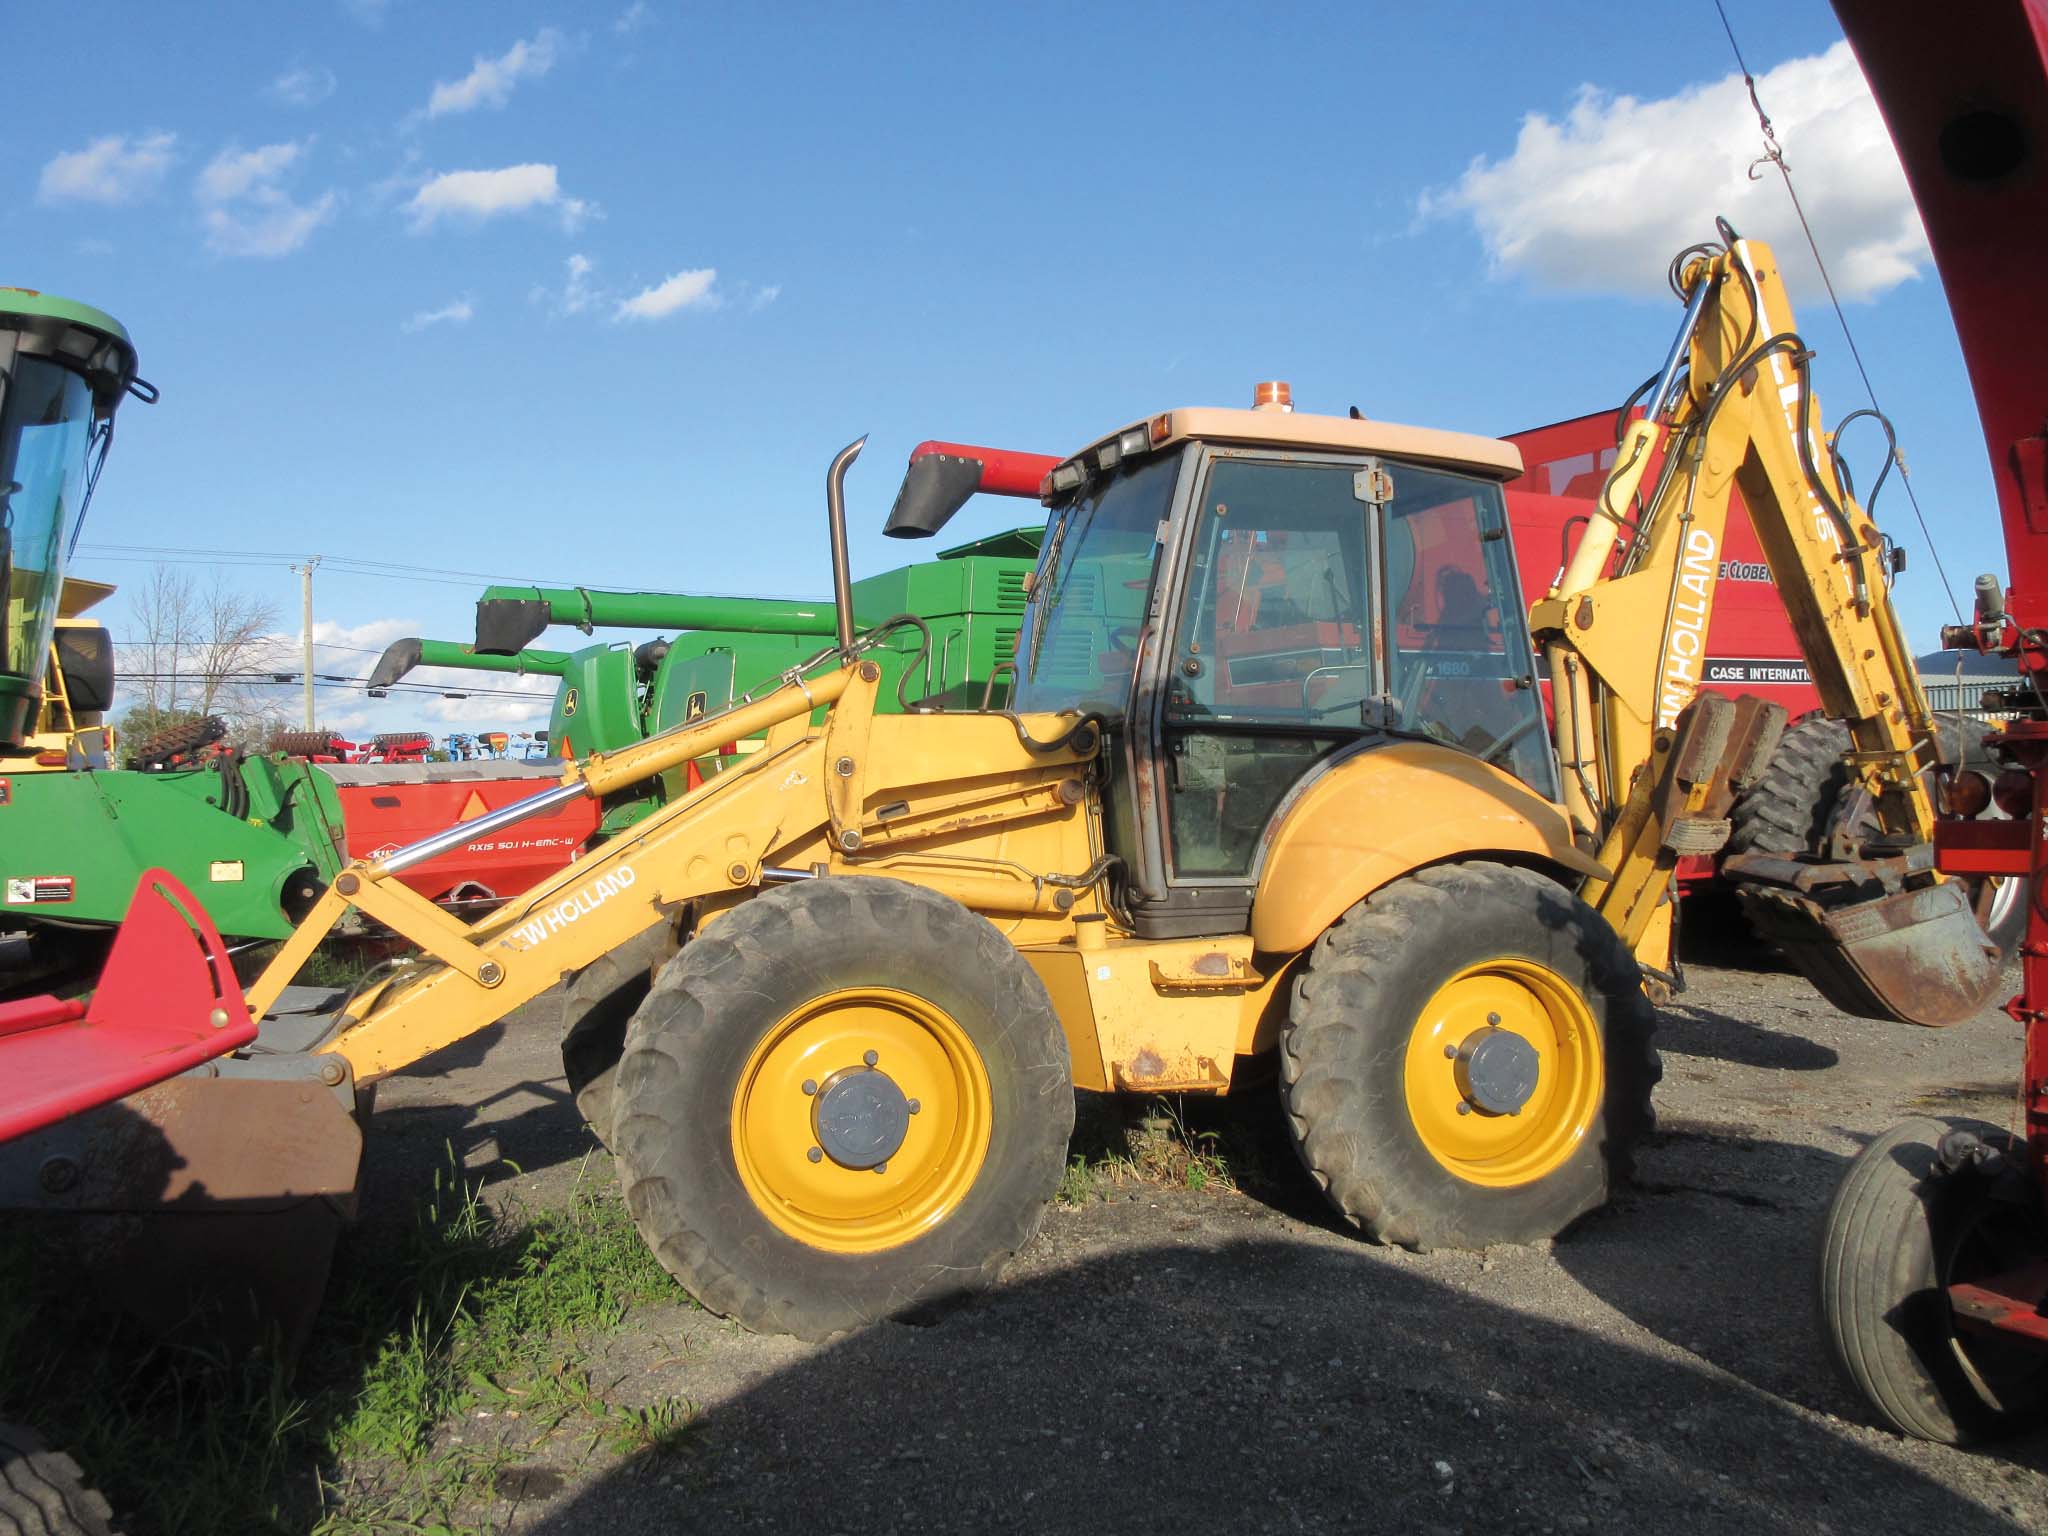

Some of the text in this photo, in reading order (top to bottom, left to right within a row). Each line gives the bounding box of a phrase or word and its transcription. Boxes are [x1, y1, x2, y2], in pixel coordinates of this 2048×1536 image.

[1667, 529, 1715, 682] HOLLAND
[1710, 666, 1744, 680] CASE
[468, 843, 494, 852] AXIS
[544, 865, 636, 933] HOLLAND
